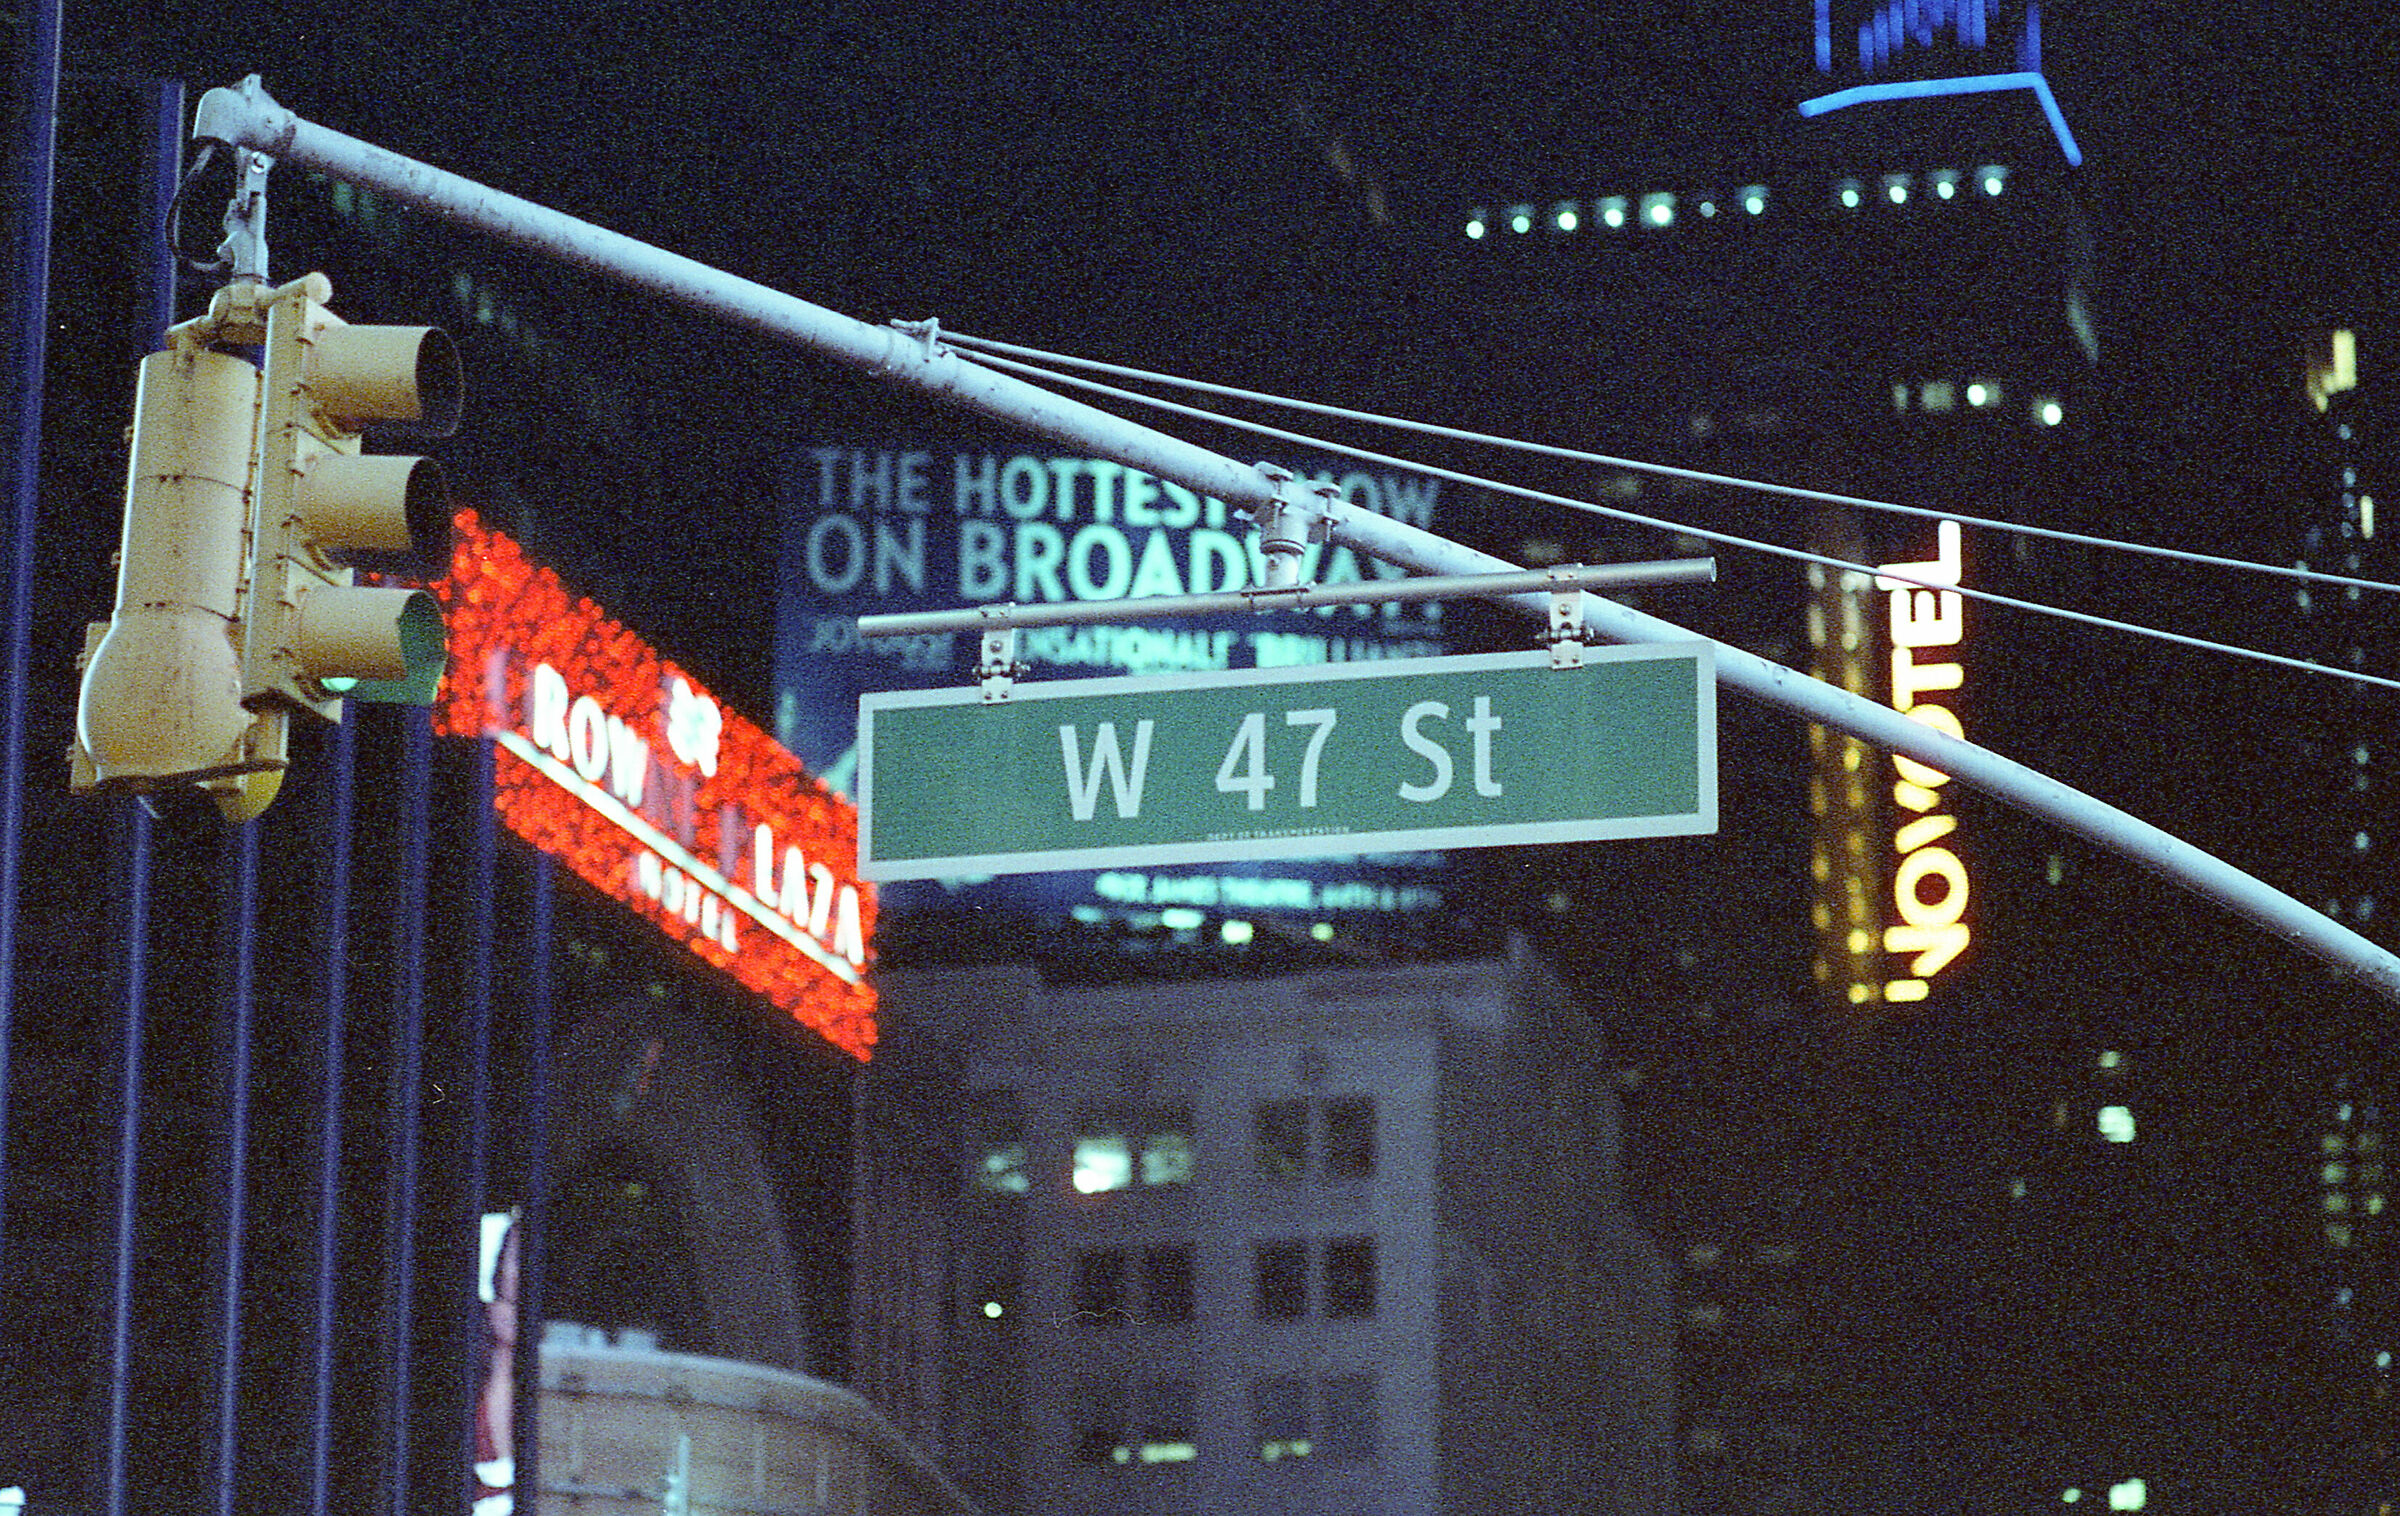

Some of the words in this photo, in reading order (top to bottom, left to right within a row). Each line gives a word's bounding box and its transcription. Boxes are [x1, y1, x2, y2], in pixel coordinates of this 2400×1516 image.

[807, 448, 931, 509] THE
[807, 513, 926, 594] ON
[1059, 719, 1154, 822] W
[1215, 708, 1338, 812] 47
[1399, 695, 1503, 803] St
